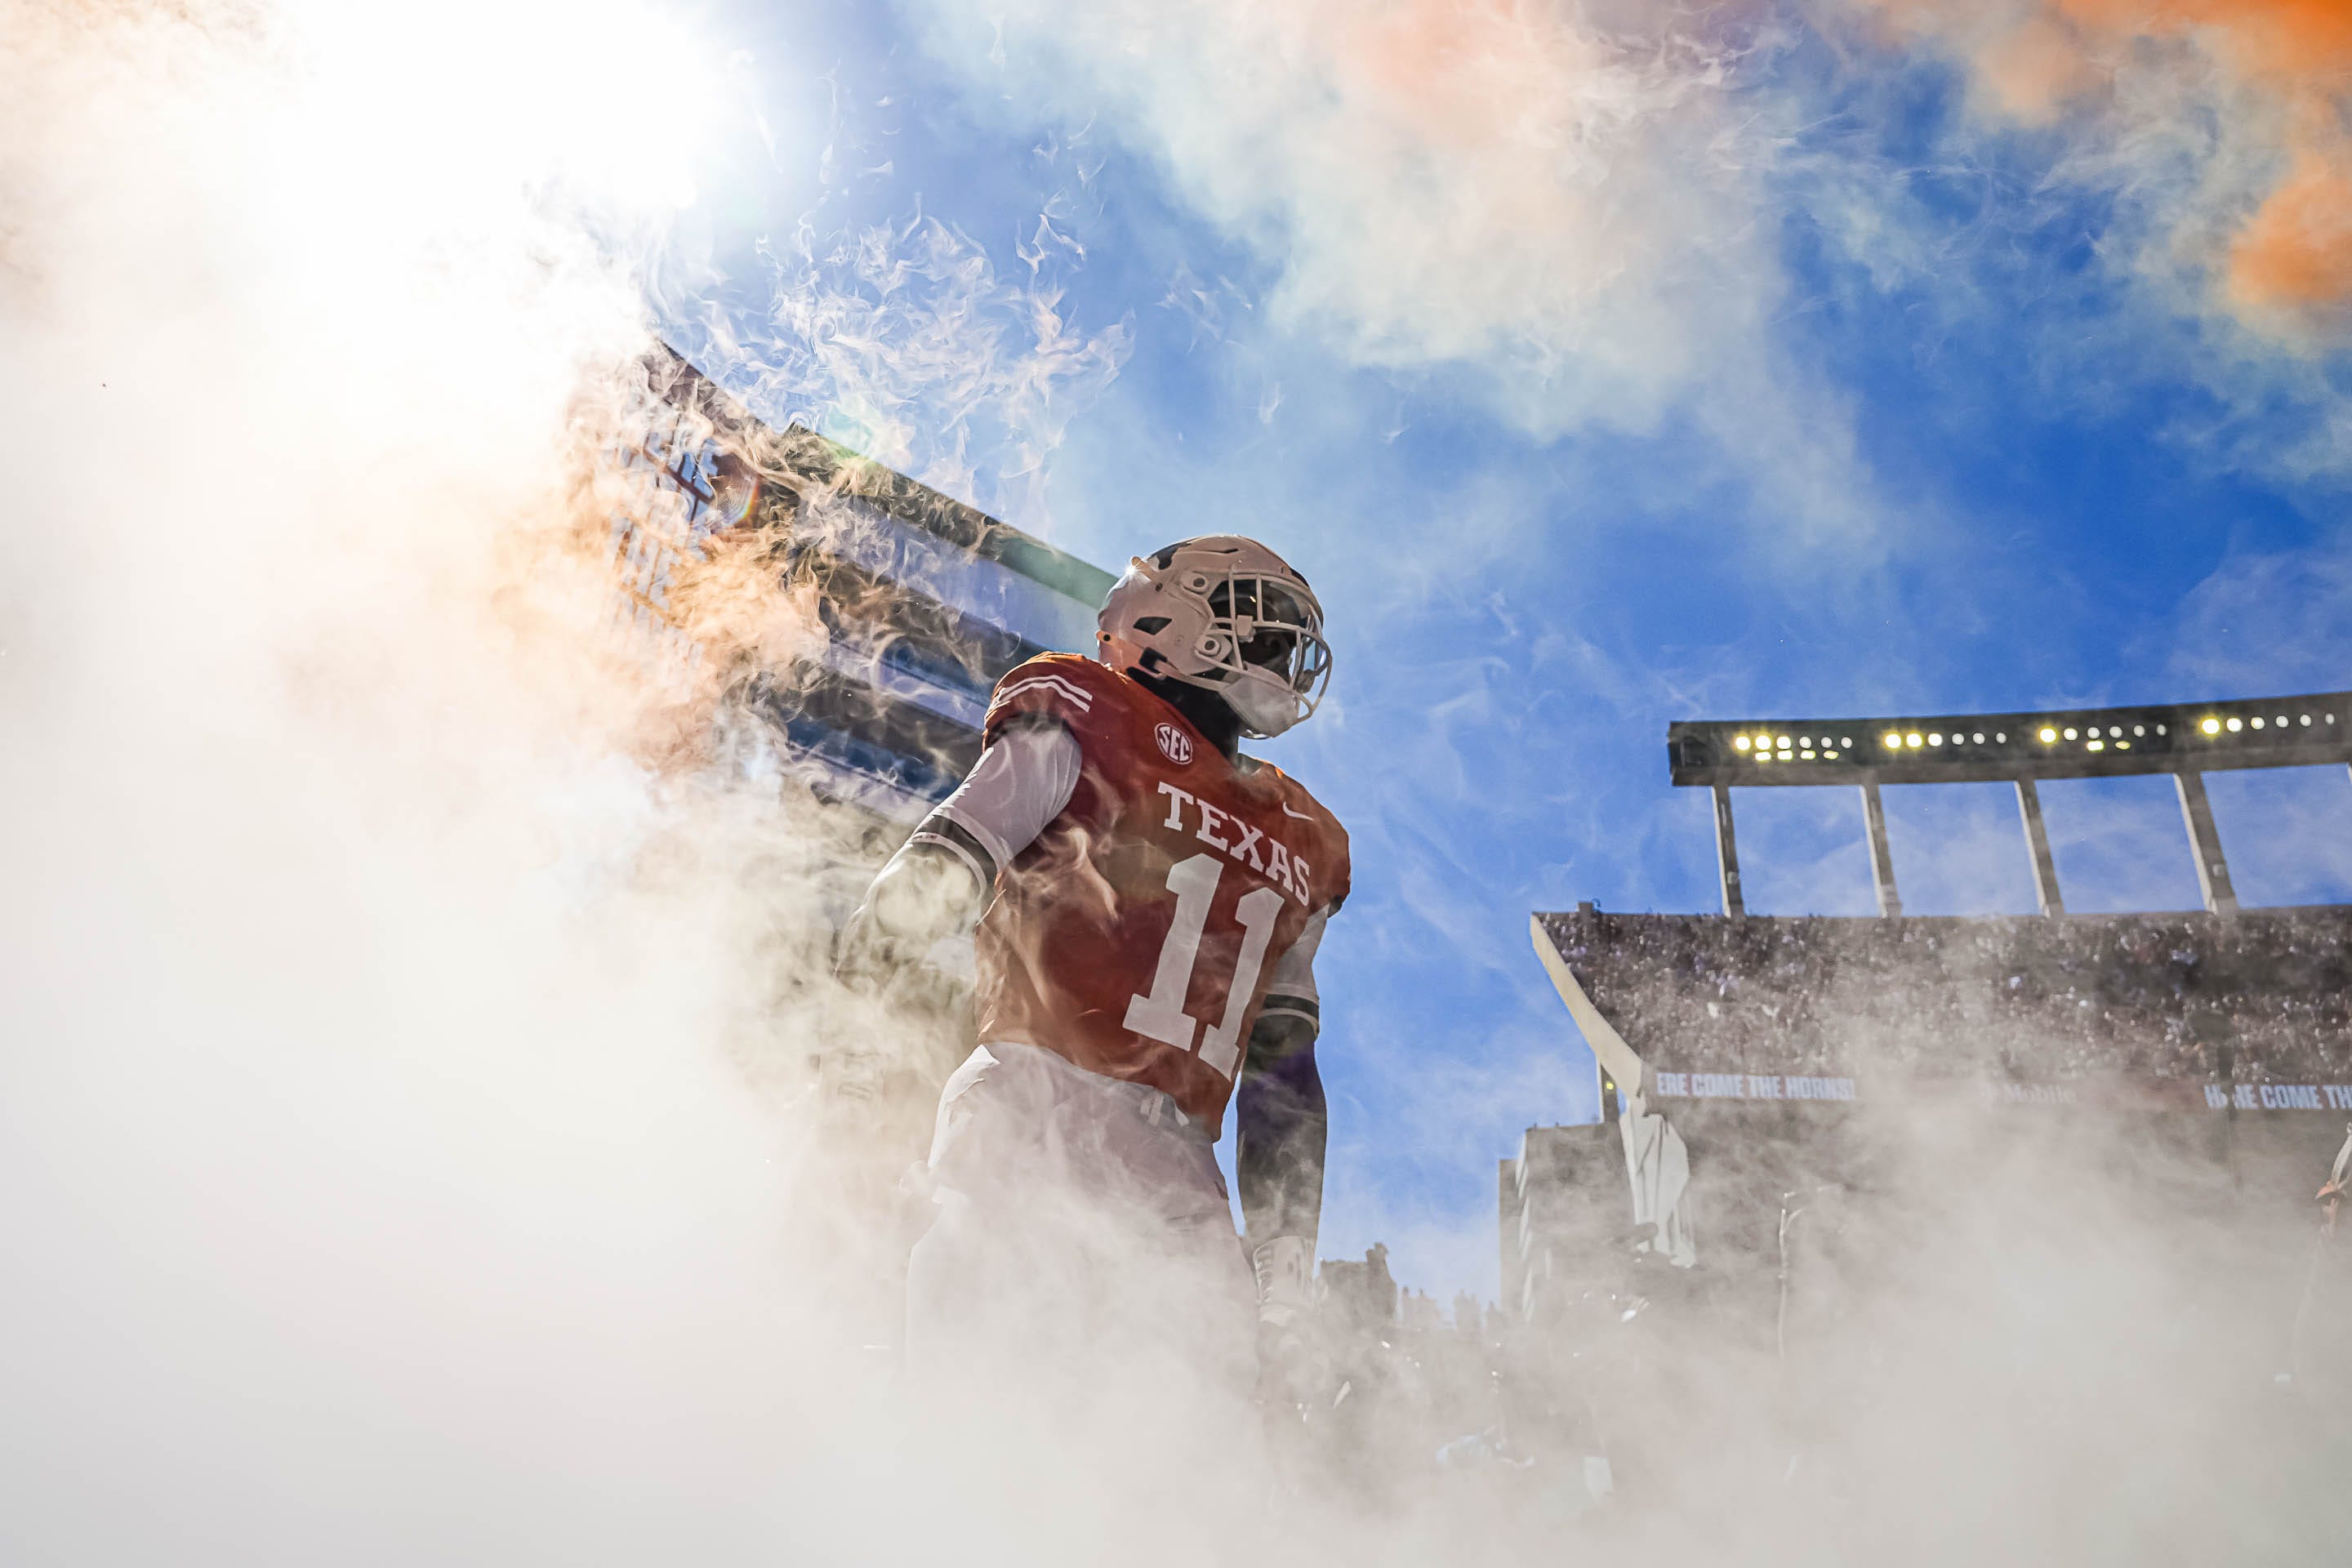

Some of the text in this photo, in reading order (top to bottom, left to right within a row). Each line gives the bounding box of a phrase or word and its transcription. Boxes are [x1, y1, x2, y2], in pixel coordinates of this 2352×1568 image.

[1159, 726, 1190, 761] SEC
[1157, 782, 1310, 906] TEXAS
[1122, 853, 1285, 1081] 11
[1692, 1073, 1744, 1098] COME
[1746, 1075, 1782, 1099] THE
[2259, 1085, 2323, 1109] COME
